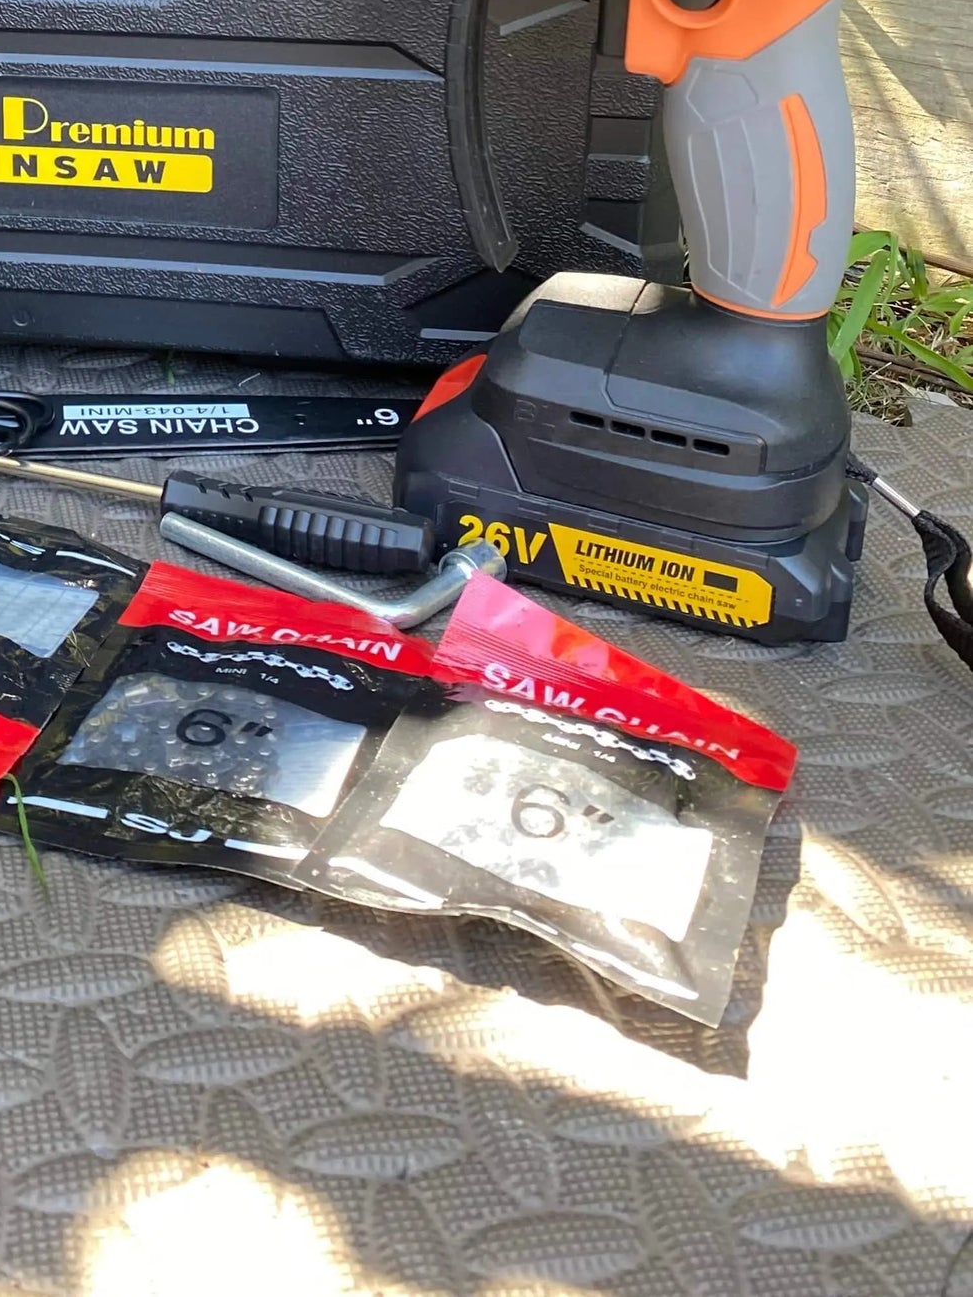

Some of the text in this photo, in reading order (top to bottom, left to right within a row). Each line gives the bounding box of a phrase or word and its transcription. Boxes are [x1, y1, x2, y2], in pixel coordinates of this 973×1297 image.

[2, 96, 215, 150] Premium
[59, 418, 260, 436] CHAIN SAW
[80, 405, 231, 417] 1/4-043-MINI
[458, 514, 696, 582] 26V LITHIUM ION
[579, 564, 737, 610] Special battery electric chain saw
[168, 609, 403, 662] SAW CHAIN
[214, 667, 247, 675] MINI
[483, 661, 585, 710] SAW
